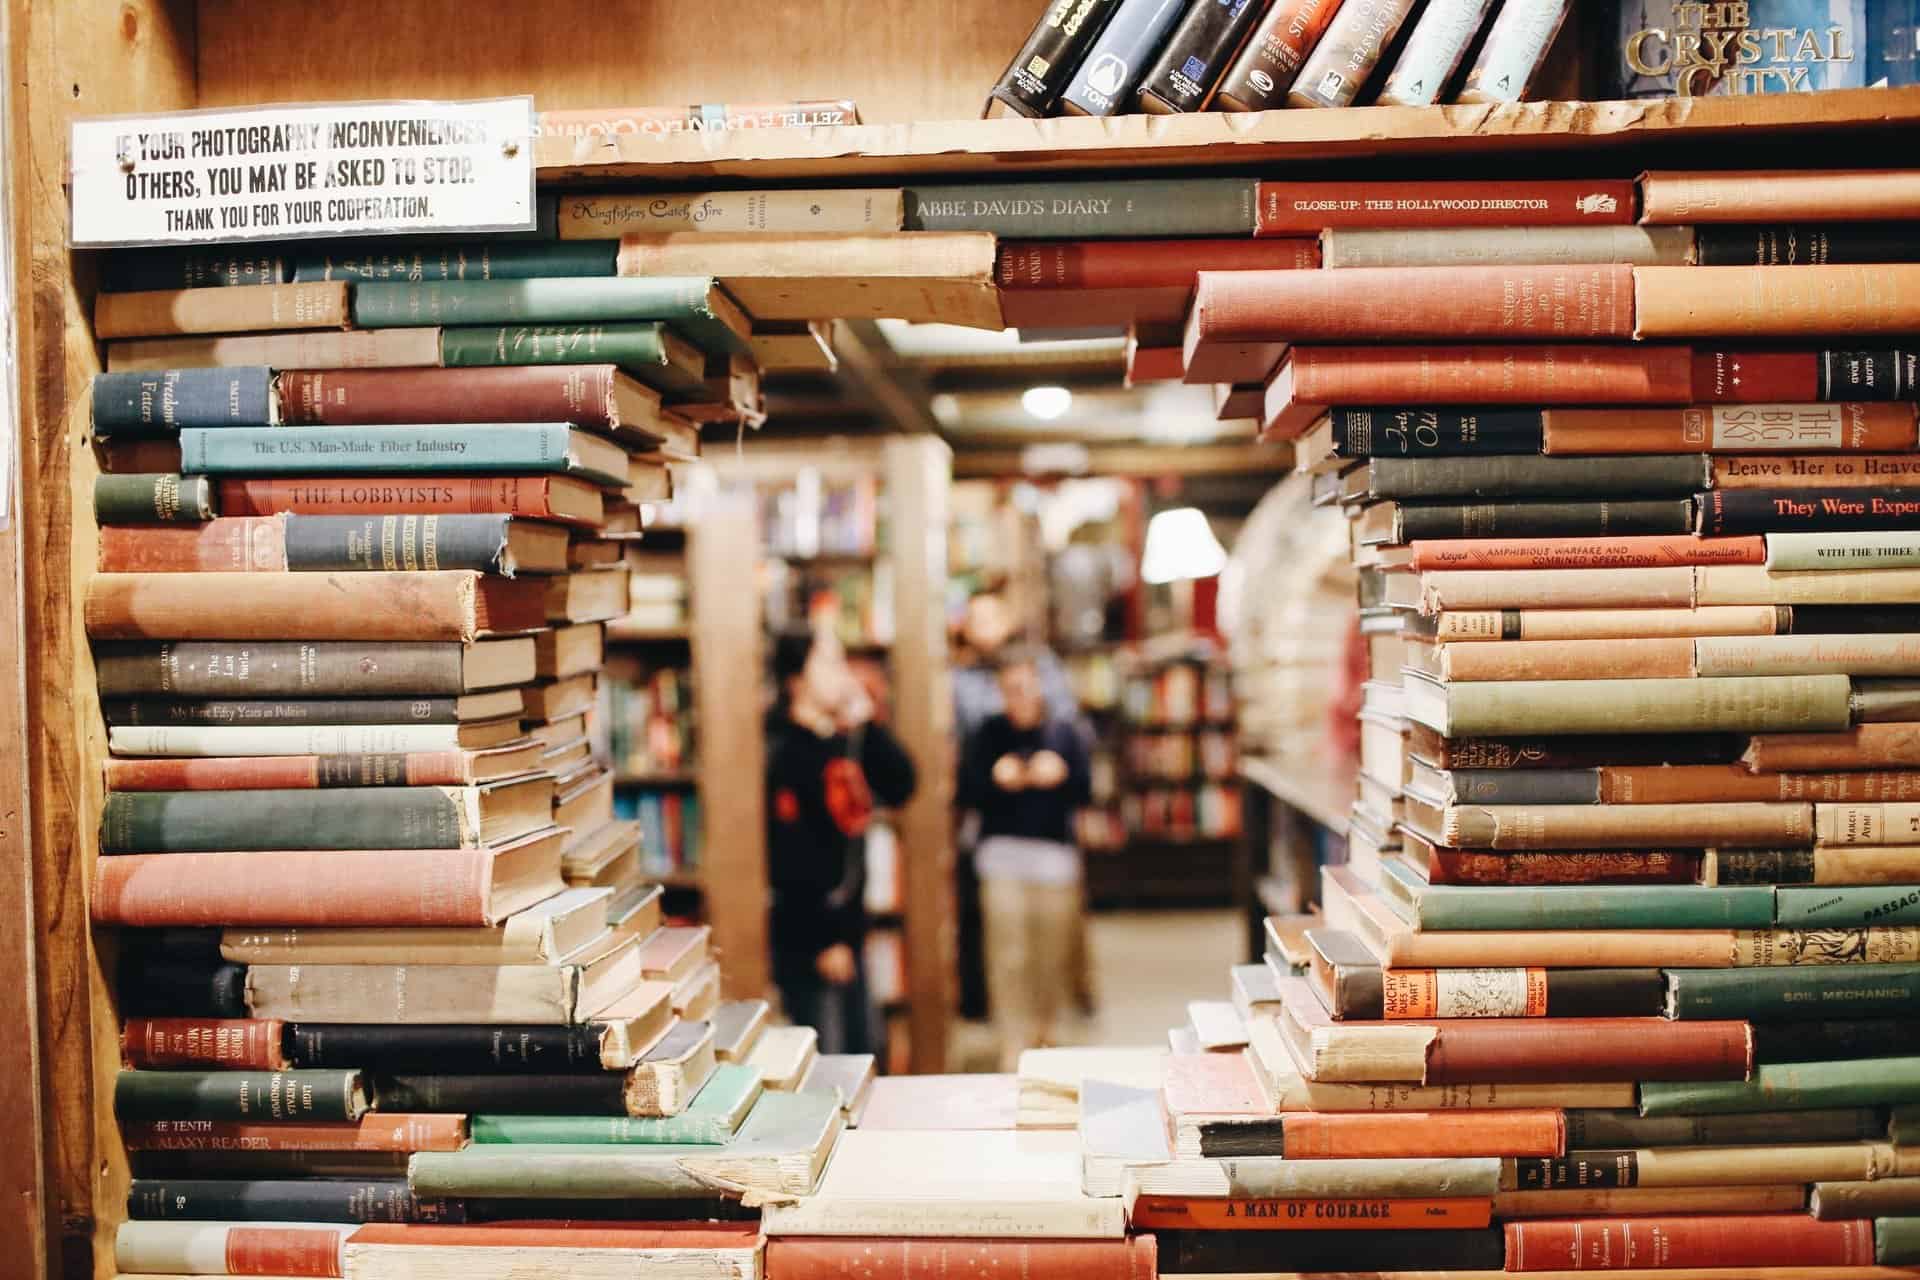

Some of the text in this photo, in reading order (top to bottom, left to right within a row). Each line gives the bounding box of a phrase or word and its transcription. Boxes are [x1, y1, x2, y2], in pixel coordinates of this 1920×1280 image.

[1671, 1, 1750, 29] THE
[1625, 27, 1854, 76] CRYSTAL
[1677, 64, 1809, 98] CITY
[1081, 86, 1109, 110] TOR
[779, 111, 843, 127] ZETTEL
[116, 119, 488, 161] IF YOUR PHOTOGRAPHY INCONVENIENCES
[126, 156, 475, 200] OTHERS, YOU MAY BE ASKED TO STOP.
[165, 196, 434, 232] THANK YOU FOR YOUR COOPERATION.
[649, 200, 690, 220] Catch
[693, 200, 723, 222] Fire
[916, 199, 1112, 218] ABBE DAVID'S DIARY
[1294, 198, 1548, 211] CLOSE-UP: THE HOLLYWOOD DIRECTOR
[1503, 279, 1514, 326] BEGINS
[1521, 279, 1534, 329] REASON
[1866, 358, 1874, 388] GLORY
[141, 381, 157, 423] Fetters
[230, 379, 239, 416] SMITH
[1722, 411, 1756, 442] SKY
[1761, 411, 1794, 441] BIG
[1800, 410, 1831, 440] THE
[253, 439, 468, 454] The U.S. Man-Made Fiber Industry
[1728, 461, 1781, 476] Leave
[1790, 460, 1824, 476] Her
[1835, 462, 1854, 475] to
[289, 486, 453, 505] THE LOBBYISTS
[1773, 498, 1864, 517] They Were
[1435, 545, 1628, 562] Keyes AMPHIBIOUS WARFARE AND
[1531, 549, 1744, 566] COMBINED OPERATIONS Macmillan
[1817, 546, 1913, 558] WITH THE THREE
[208, 654, 219, 677] The
[224, 655, 234, 676] Last
[238, 651, 249, 680] Battle
[1385, 975, 1396, 1013] ARCHY
[1409, 982, 1418, 1006] PART
[1528, 973, 1537, 1015] DOUBLEDAY
[1783, 988, 1910, 1003] SOIL MECHANICS
[286, 1079, 297, 1115] METALS
[303, 1084, 313, 1111] LIGHT
[174, 1120, 212, 1132] TENTH
[212, 1136, 271, 1150] READER
[1226, 1203, 1391, 1218] A MAN OF COURAGE
